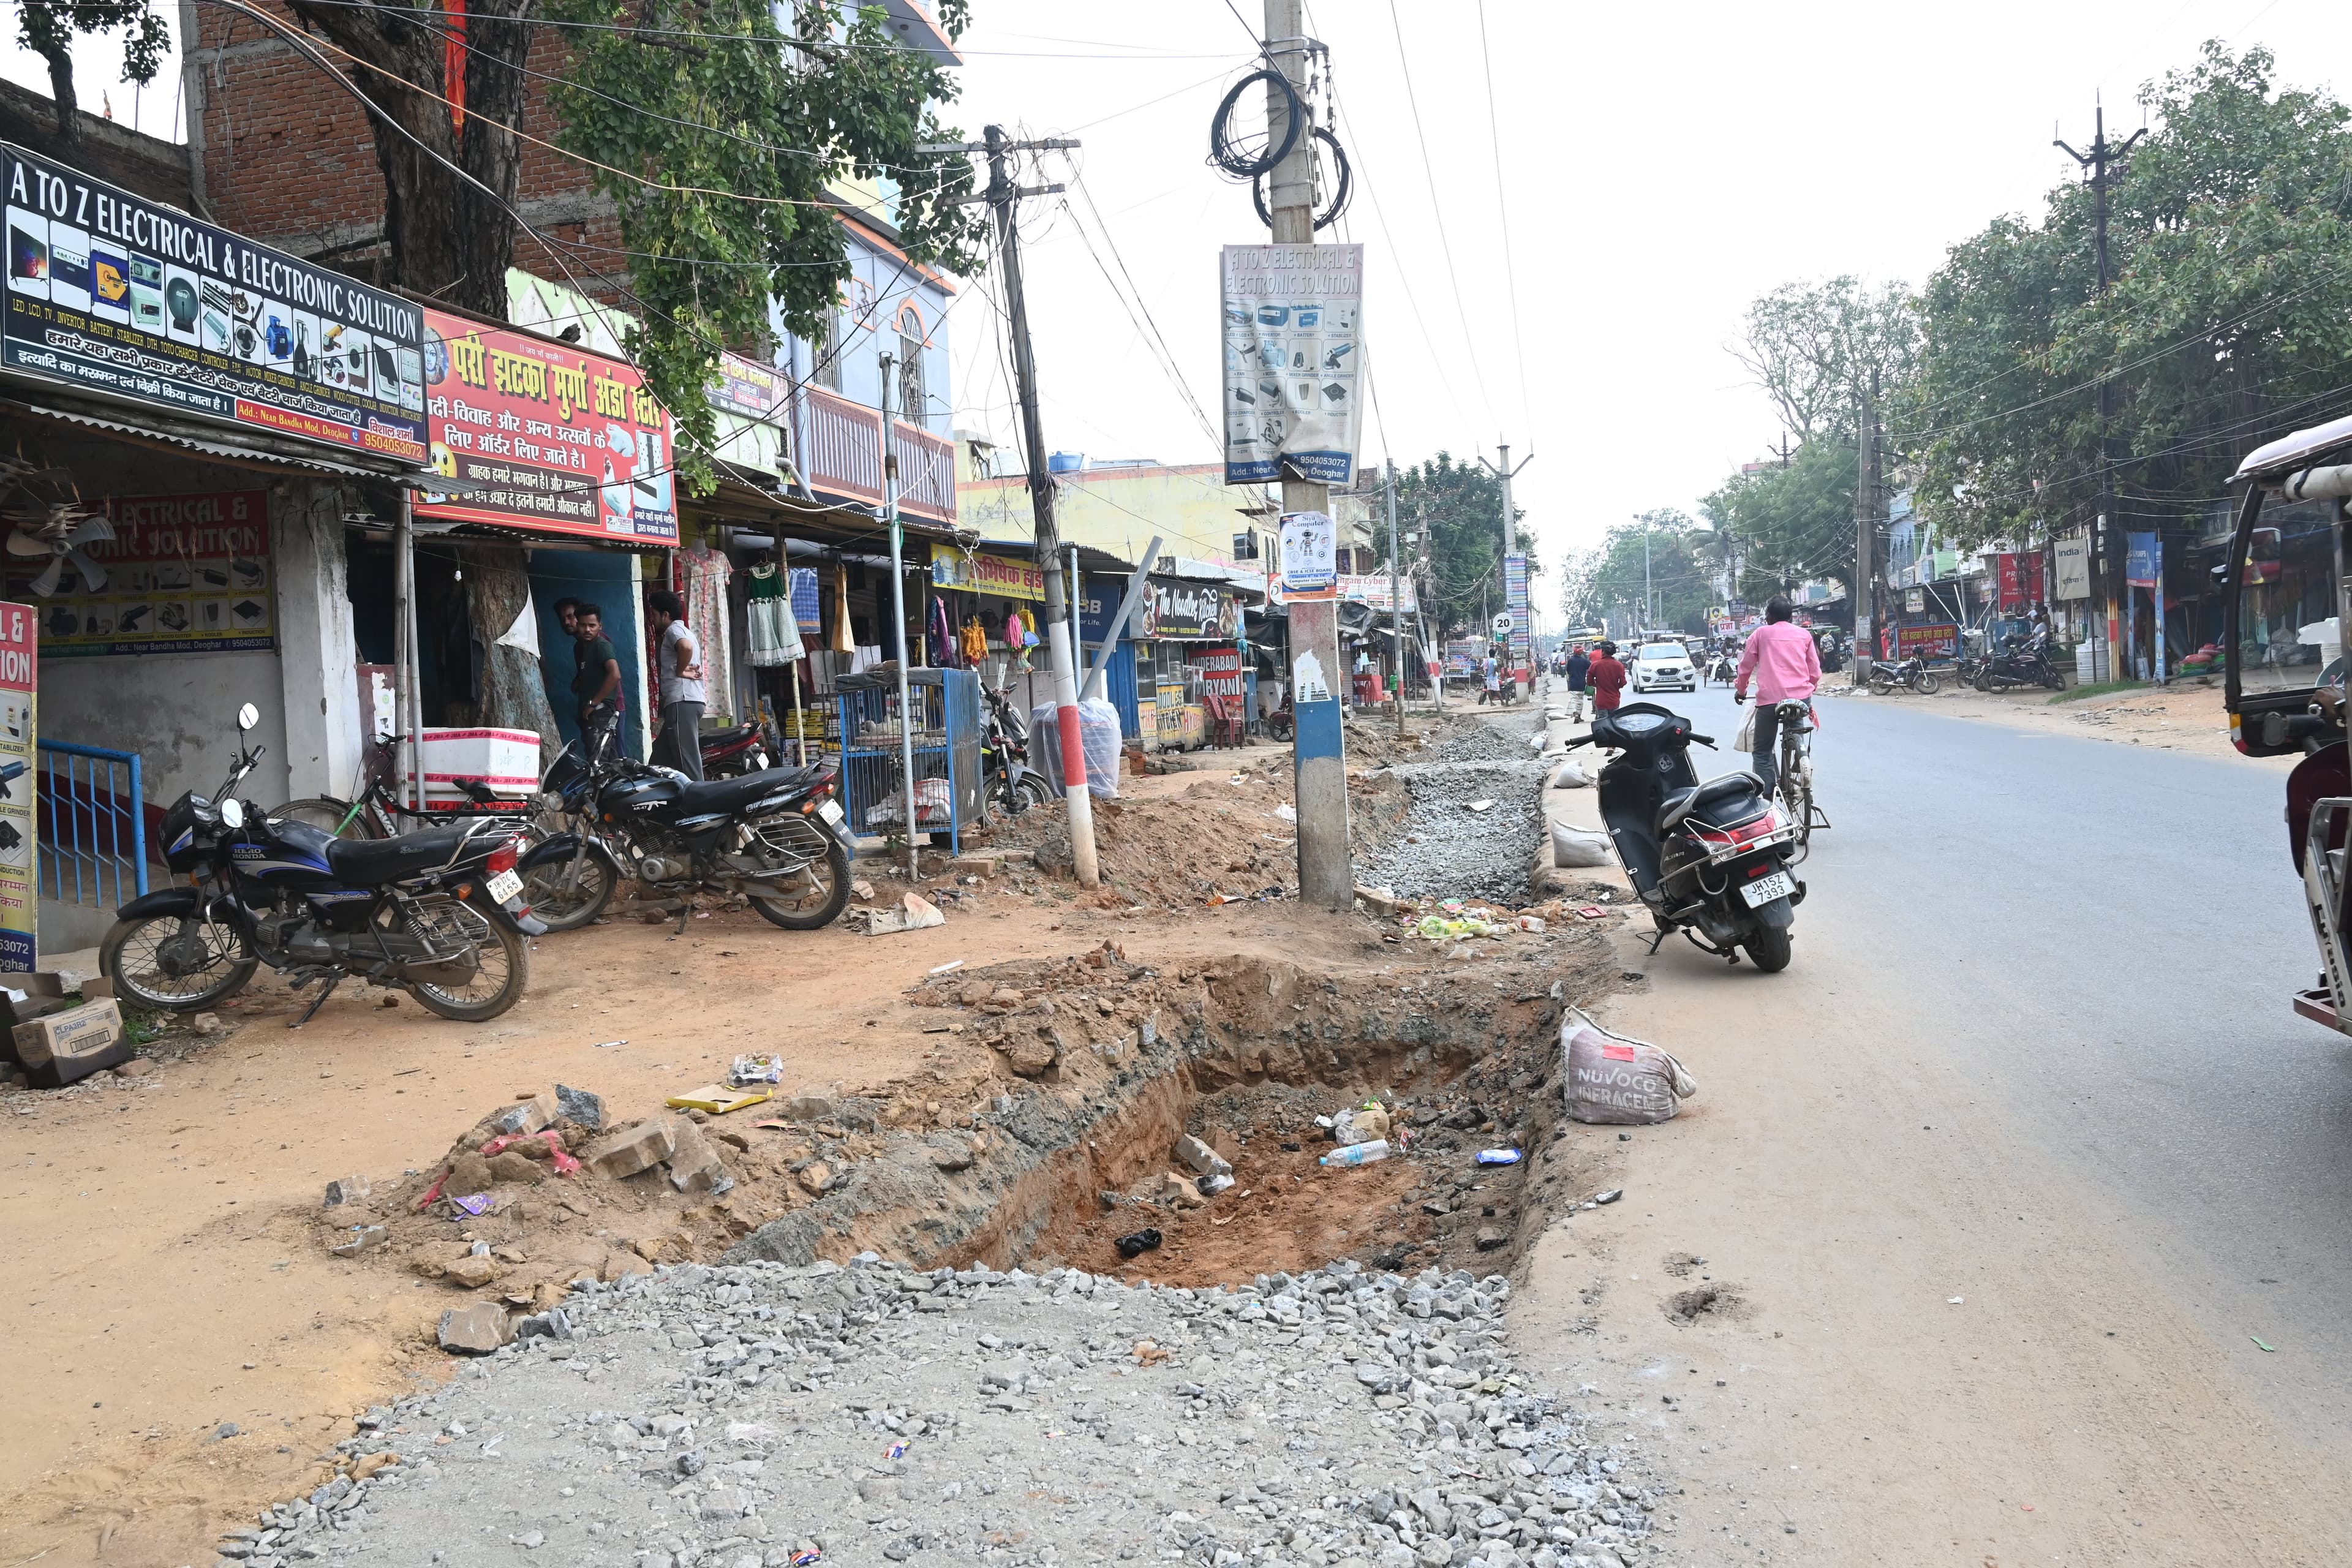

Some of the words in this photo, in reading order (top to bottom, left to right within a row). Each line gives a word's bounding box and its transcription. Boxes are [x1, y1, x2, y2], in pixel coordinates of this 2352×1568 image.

[11, 162, 28, 204] A
[36, 169, 67, 217] TO
[75, 185, 89, 226] Z
[97, 193, 217, 273] ELECTRICAL
[224, 243, 236, 279] &
[242, 250, 343, 317] ELECTRONIC
[348, 290, 416, 342] SOLUTION
[1242, 249, 1259, 270] TO
[1273, 248, 1343, 271] ELECTRICAL
[1226, 274, 1297, 296] ELECTRONIC
[1300, 274, 1359, 295] SOLUTION
[13, 299, 24, 312] LED
[58, 311, 85, 330] INVERTOR
[90, 321, 113, 338] BATTERY
[117, 329, 144, 347] STABLIZER
[147, 339, 157, 350] DTH
[160, 341, 174, 355] TOTO
[175, 346, 198, 361] CHARGER
[201, 352, 228, 369] CONTROLER
[245, 366, 262, 379] MOTOR
[18, 350, 57, 369] इत्यादि
[59, 360, 76, 374] का
[78, 366, 117, 384] मरम्मत
[137, 379, 160, 395] बिक्री
[162, 384, 186, 402] किया
[188, 393, 211, 407] जाता
[47, 330, 81, 350] हमारे
[112, 347, 138, 364] सभी
[142, 355, 173, 374] प्रकार
[218, 375, 238, 391] चेक
[240, 382, 256, 396] एवं
[258, 384, 280, 402] बैटरी
[282, 393, 302, 408] चार्ज
[305, 396, 327, 415] किया
[330, 407, 351, 421] जाता
[353, 409, 361, 424] है
[451, 330, 486, 386] परी
[490, 347, 547, 401] झटका
[551, 360, 588, 420] मुर्गा
[594, 368, 627, 420] अंडा
[369, 419, 394, 437] विशाल
[397, 427, 413, 441] शर्मा
[497, 410, 521, 432] और
[526, 420, 551, 439] अन्य
[554, 425, 590, 447] उत्सवों
[594, 431, 606, 449] के
[365, 434, 422, 458] 9504053072
[443, 424, 472, 449] लिए
[478, 433, 510, 455] ऑर्डर
[514, 437, 539, 461] लिए
[543, 446, 567, 466] जाते
[1253, 466, 1270, 475] Near
[1311, 467, 1345, 478] Deoghar
[1300, 456, 1346, 467] 9504053072
[468, 464, 490, 481] ग्राहक
[492, 466, 510, 483] हमारे
[513, 471, 538, 488] भगवान
[551, 473, 562, 491] और
[535, 494, 554, 512] हमारी
[557, 496, 578, 516] औकात
[2059, 549, 2079, 557] india
[969, 556, 1020, 585] अभिषेक
[1363, 577, 1387, 586] Cyber
[1158, 587, 1170, 617] The
[1172, 589, 1198, 622] Noodles
[12, 612, 24, 643] &
[1497, 619, 1510, 628] 20
[151, 641, 175, 650] Bandha
[194, 641, 221, 650] Deoghar
[232, 638, 270, 647] 9504053072
[7, 808, 30, 816] GRINDER
[498, 881, 518, 899] 6455
[1752, 875, 1784, 894] JH15Z
[1757, 885, 1785, 903] 7393
[55, 1020, 86, 1035] CLPA3R2
[1578, 1068, 1656, 1092] NUVOCO
